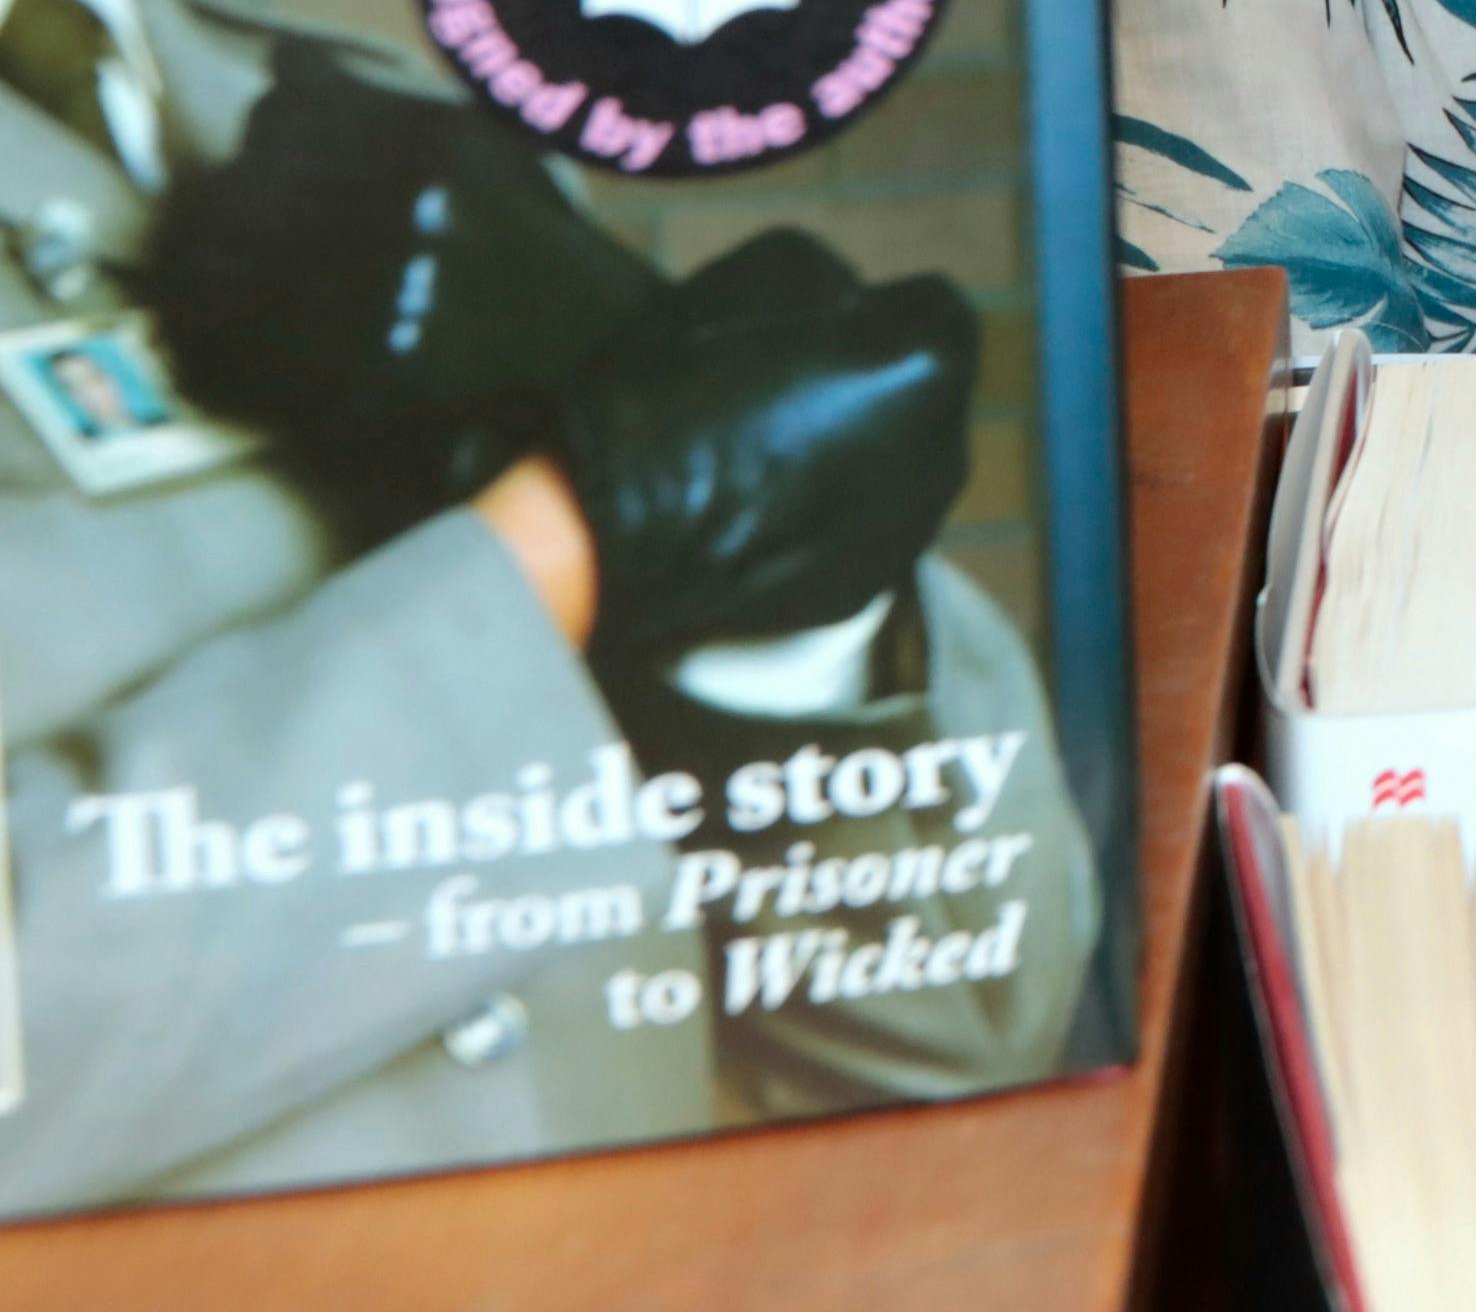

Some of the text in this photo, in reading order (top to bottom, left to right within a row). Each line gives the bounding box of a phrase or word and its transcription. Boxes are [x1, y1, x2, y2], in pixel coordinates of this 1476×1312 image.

[577, 97, 677, 174] by
[685, 99, 804, 167] the
[65, 729, 1028, 899] The inside story
[663, 832, 1031, 931] Prisoner
[602, 902, 1028, 1030] to Wicked
